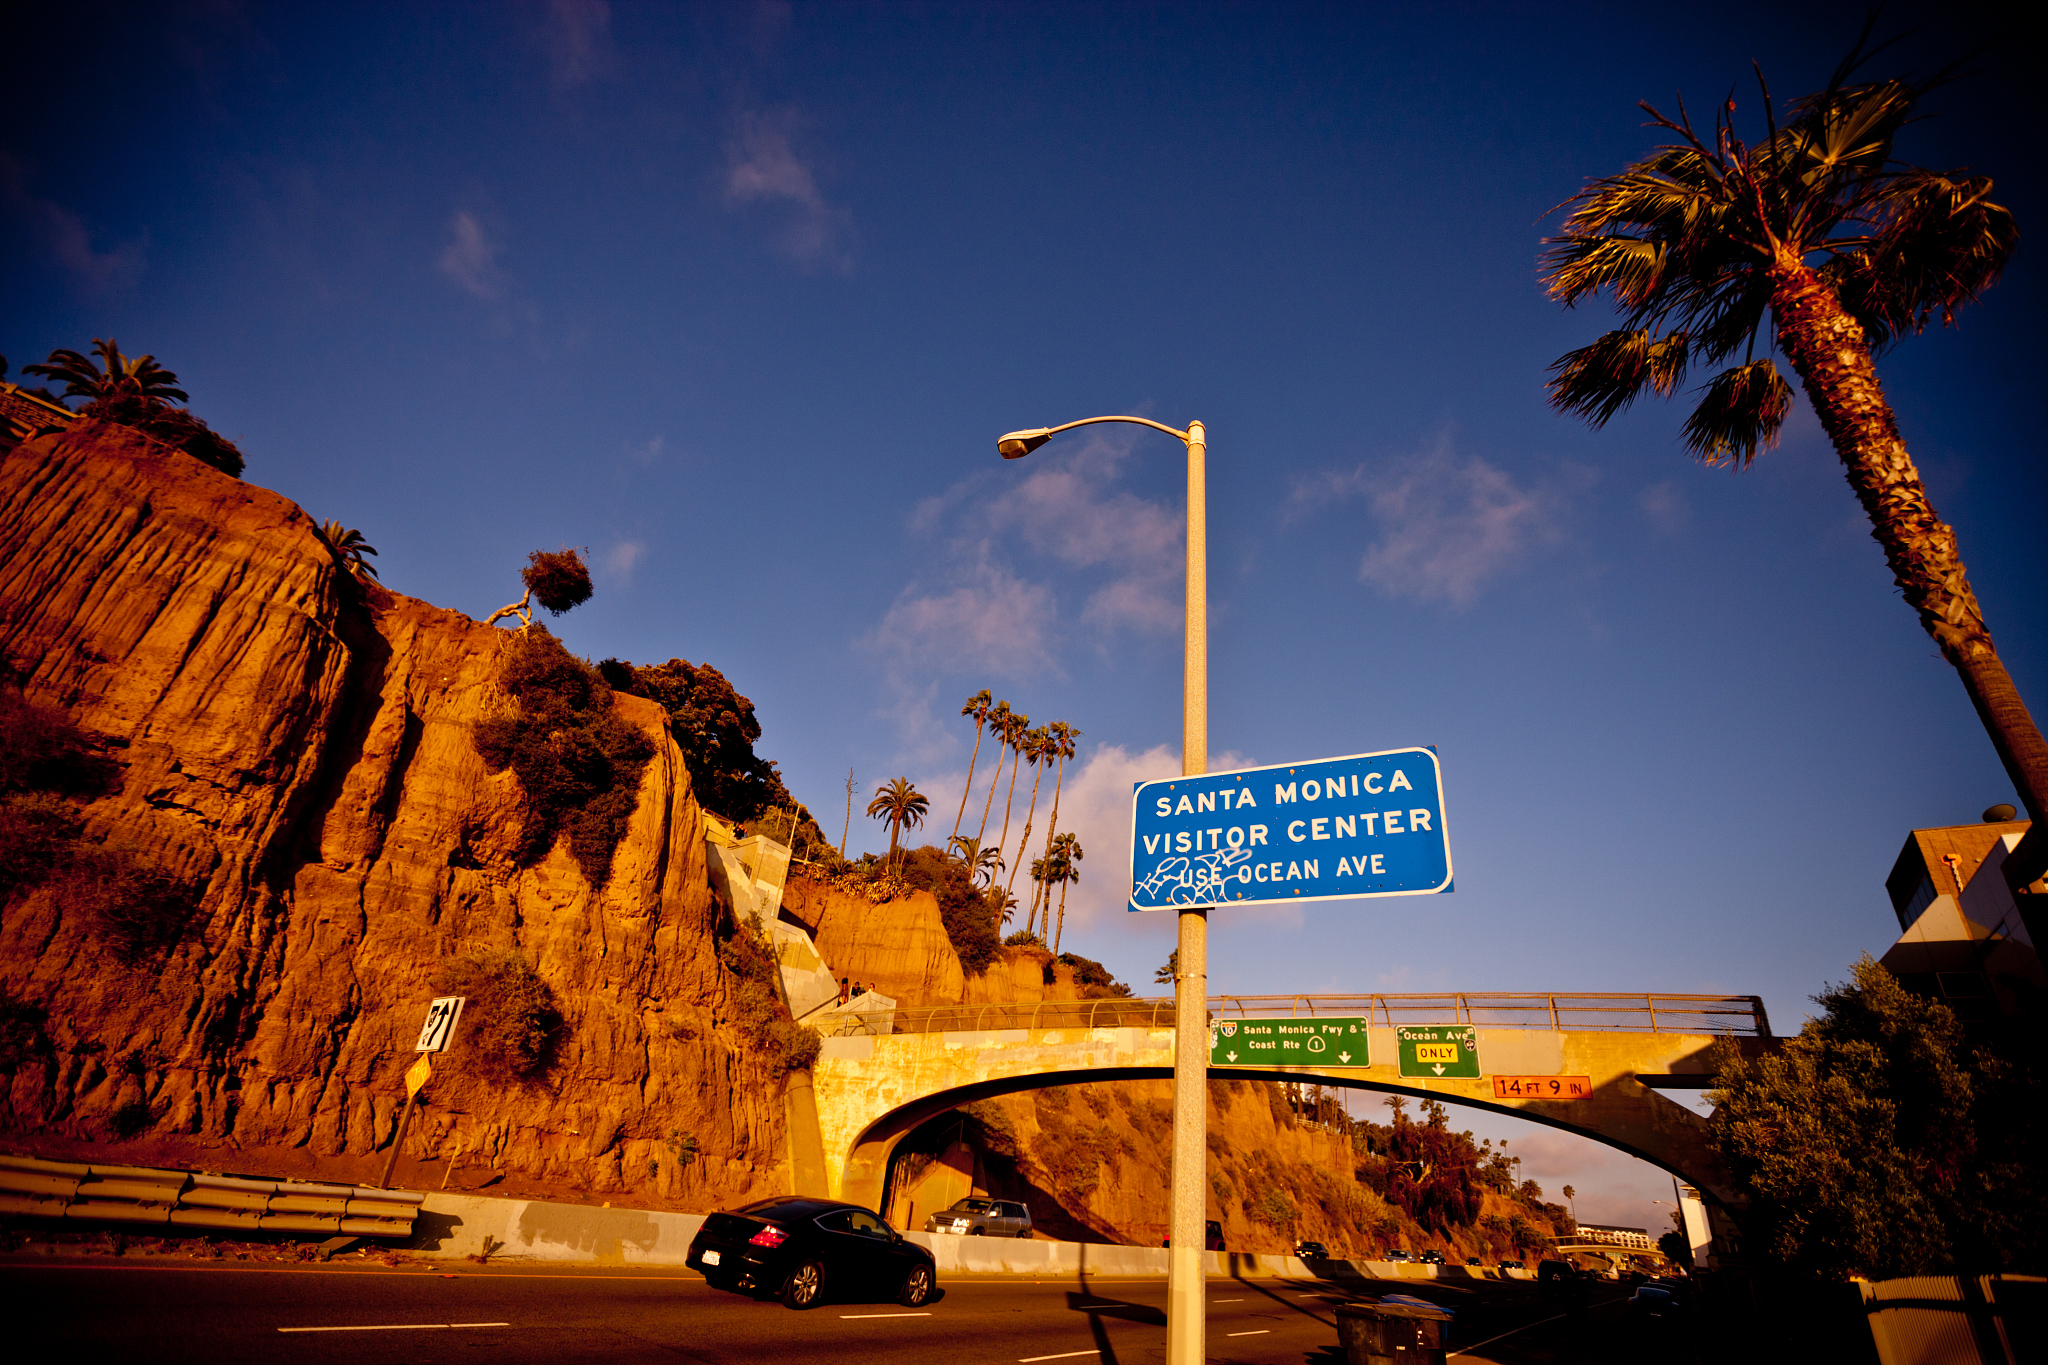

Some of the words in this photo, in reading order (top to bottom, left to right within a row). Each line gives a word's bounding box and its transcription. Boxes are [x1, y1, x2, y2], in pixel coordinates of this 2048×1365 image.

[1155, 787, 1257, 818] SANTA
[1275, 769, 1413, 805] MONICA
[1142, 824, 1269, 855] VISITOR
[1287, 808, 1432, 843] CENTER
[1179, 866, 1223, 888] USE
[1237, 859, 1319, 884] OCEAN
[1336, 854, 1386, 877] AVE
[1224, 1026, 1234, 1036] 10
[1243, 1026, 1272, 1035] Santa
[1278, 1025, 1315, 1035] Monica
[1322, 1025, 1343, 1036] Fwy
[1349, 1026, 1358, 1034] &
[1403, 1031, 1438, 1040] Ocean
[1446, 1031, 1468, 1040] Ave
[1248, 1041, 1276, 1049] Coast
[1283, 1041, 1301, 1049] Rte
[1420, 1048, 1453, 1058] ONLY
[1500, 1079, 1522, 1095] 14
[1526, 1082, 1541, 1094] FT
[1549, 1080, 1561, 1095] 9
[1569, 1083, 1583, 1095] IN
